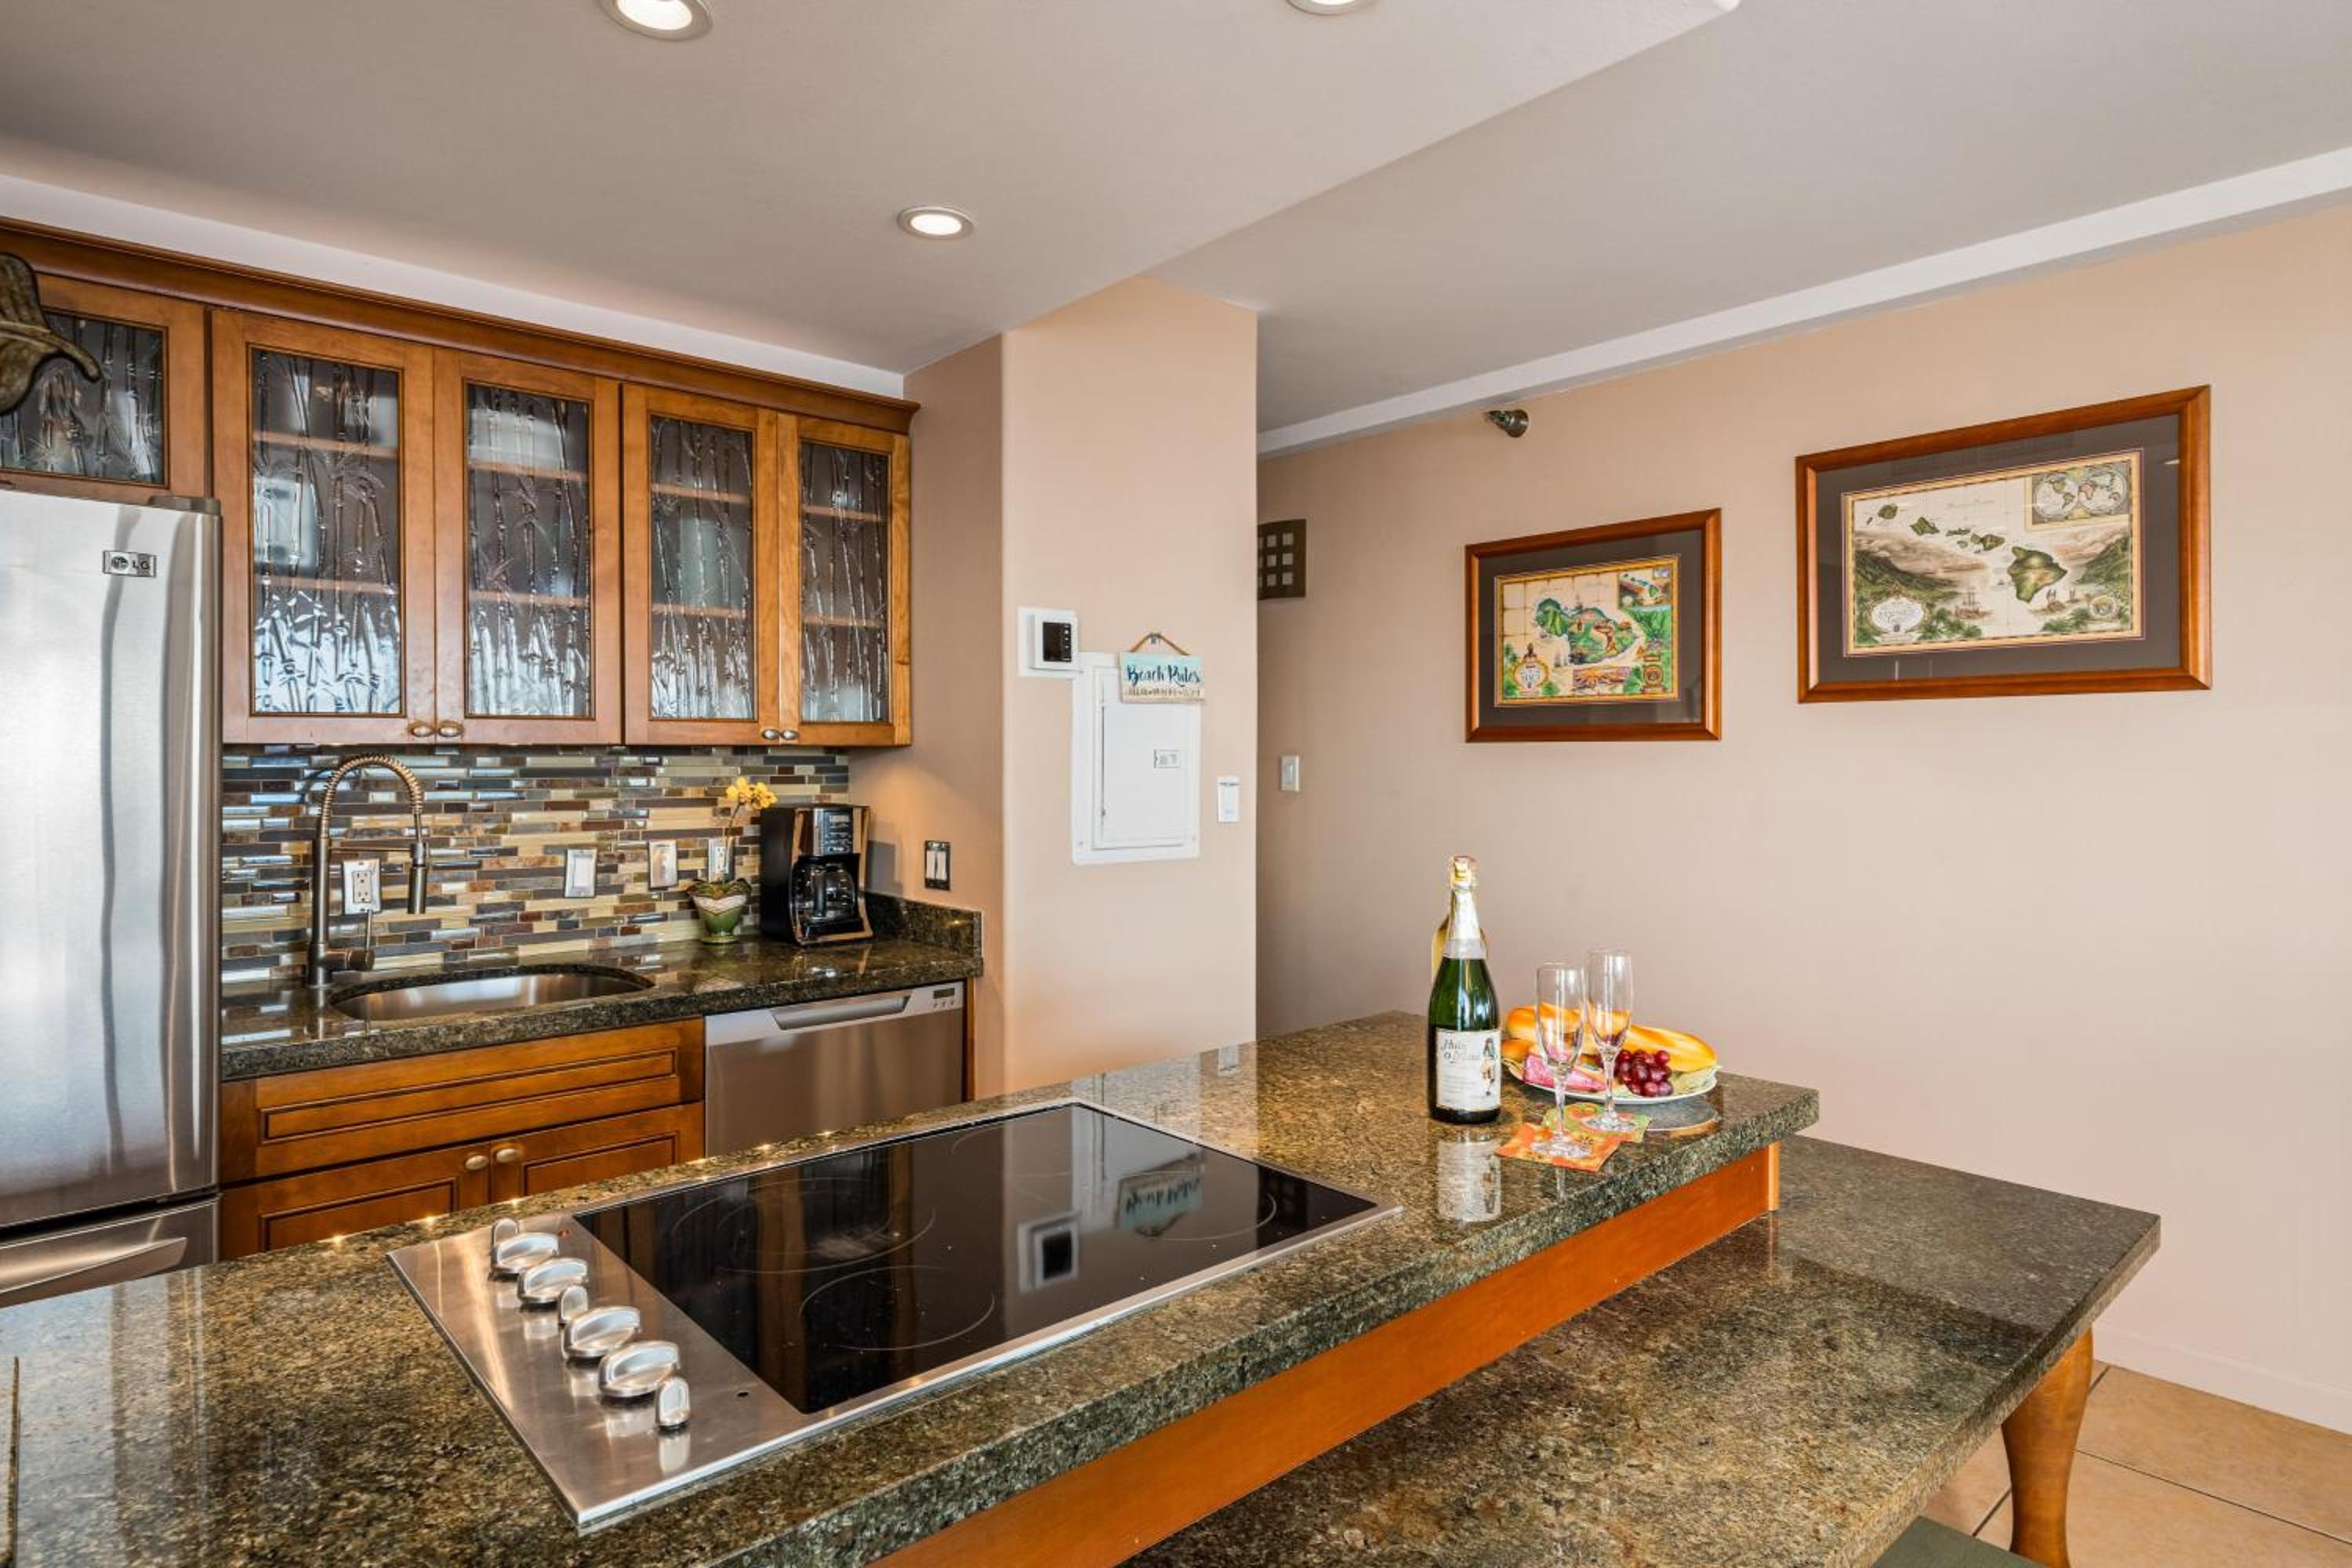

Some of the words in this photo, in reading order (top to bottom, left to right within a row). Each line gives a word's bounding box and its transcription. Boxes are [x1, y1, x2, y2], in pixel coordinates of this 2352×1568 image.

[132, 560, 151, 570] LG
[1127, 664, 1165, 687] Beach
[1167, 664, 1201, 688] Rules
